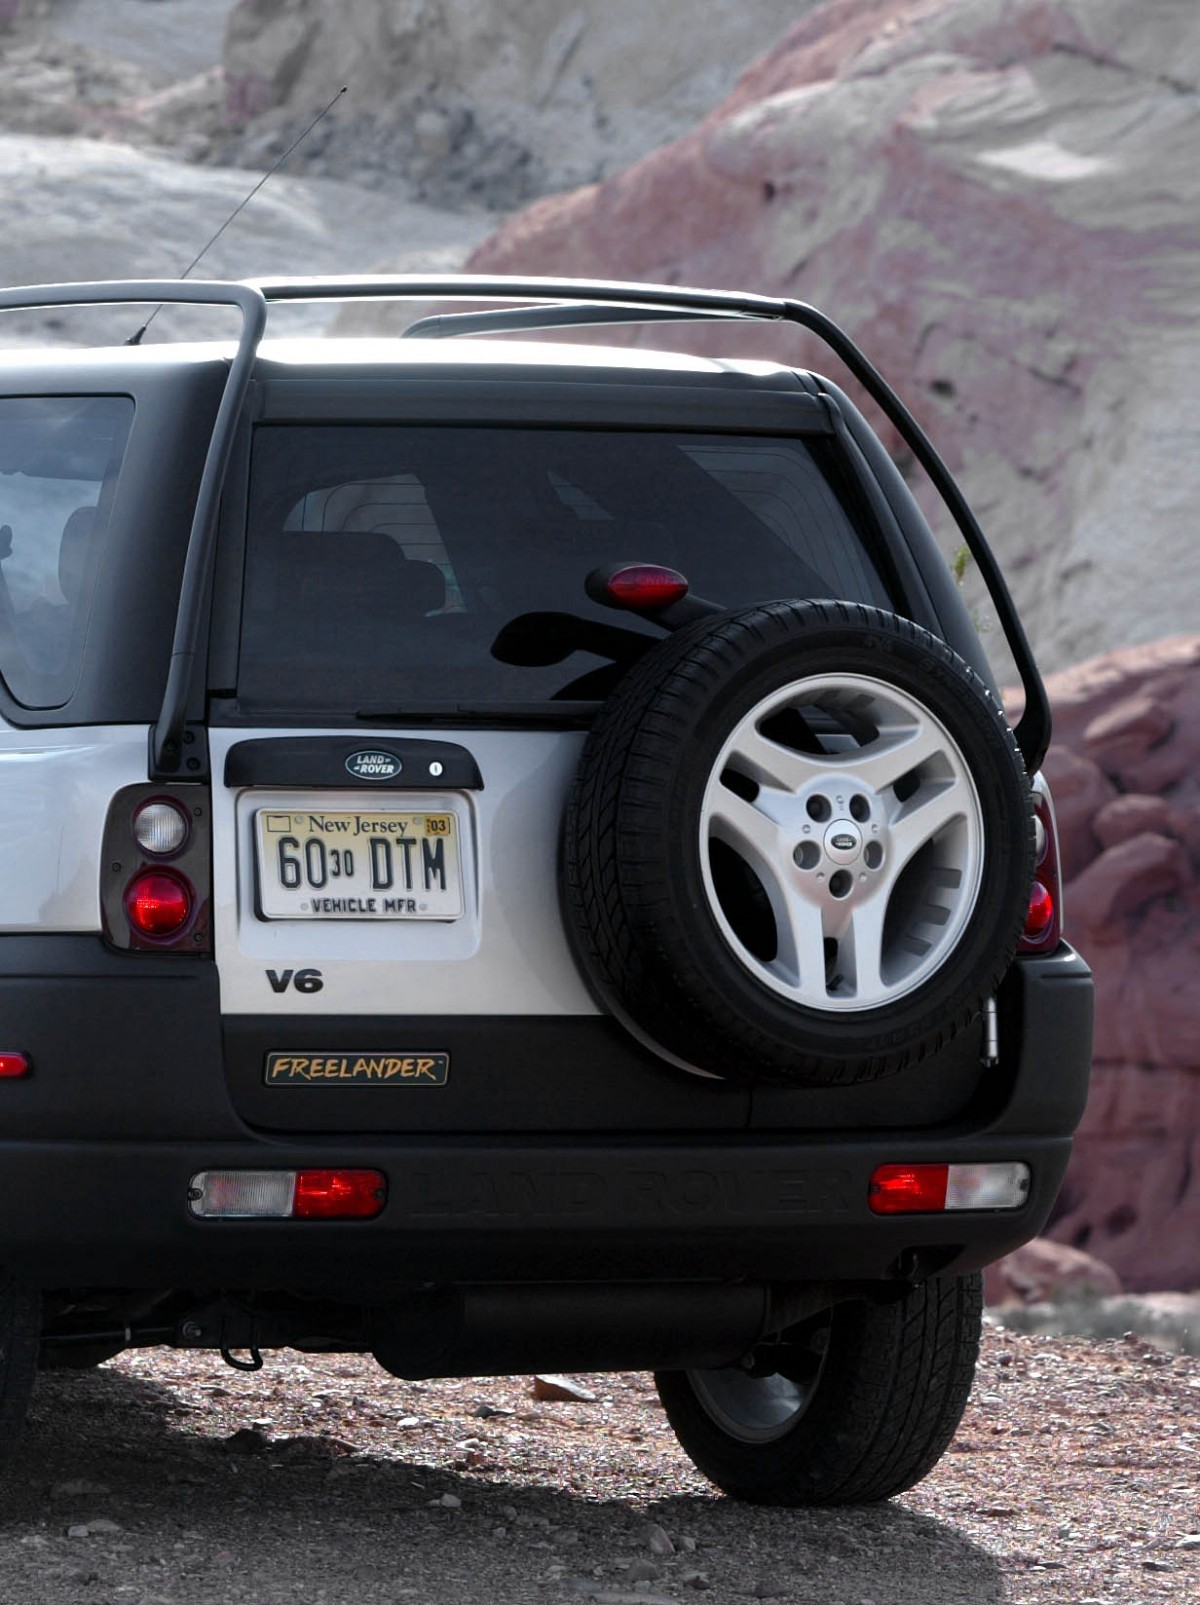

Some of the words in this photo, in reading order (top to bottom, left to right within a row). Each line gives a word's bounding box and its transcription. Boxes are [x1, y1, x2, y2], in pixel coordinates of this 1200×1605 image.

[357, 755, 384, 764] LAND
[360, 764, 394, 774] ROVER
[309, 816, 350, 833] New
[353, 816, 408, 836] Jersey
[431, 819, 446, 832] 03
[369, 837, 446, 890] DTM
[312, 899, 376, 912] VEHICLE
[384, 899, 416, 912] MFR
[265, 968, 323, 993] V6
[272, 1057, 436, 1080] FREELANDER
